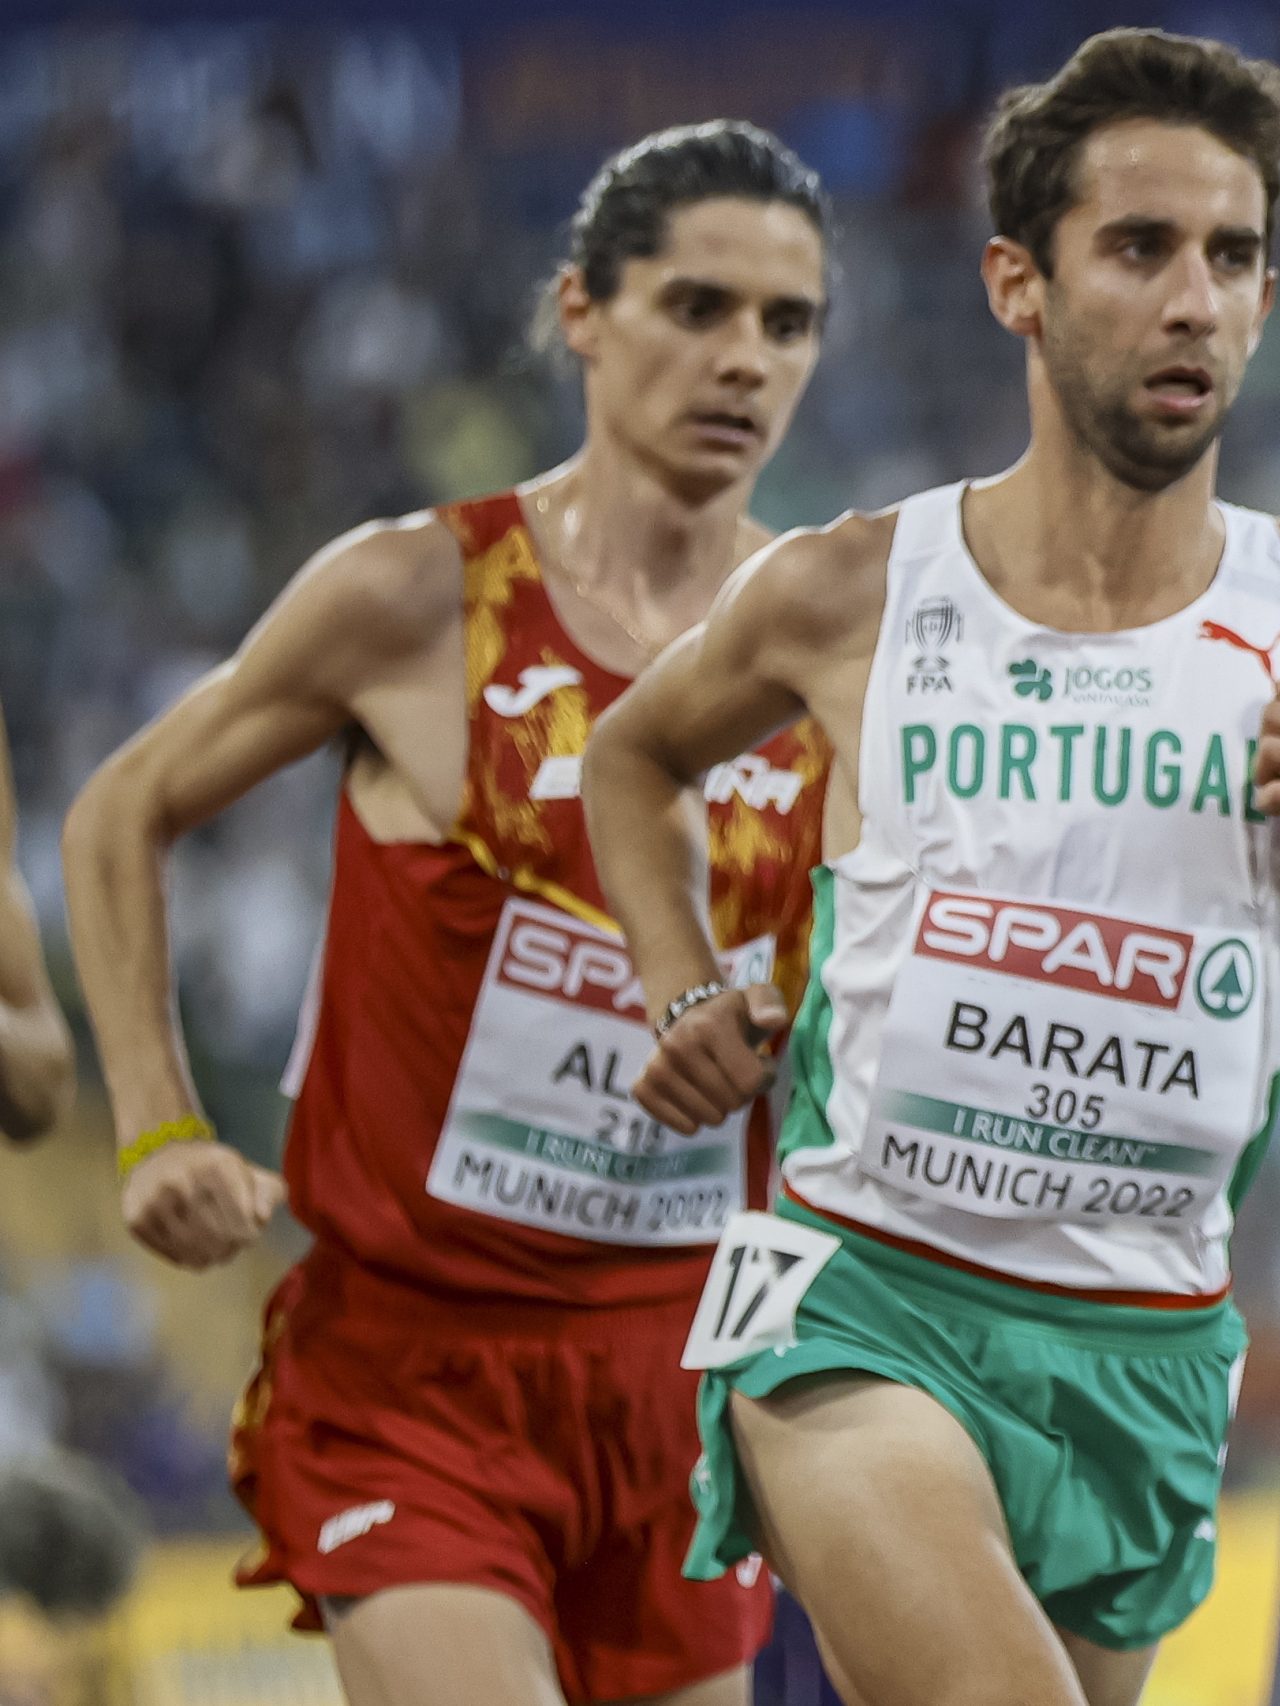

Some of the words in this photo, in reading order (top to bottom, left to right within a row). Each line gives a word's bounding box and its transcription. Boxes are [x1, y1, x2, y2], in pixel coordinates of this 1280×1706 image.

[906, 675, 954, 695] FPA
[1064, 665, 1153, 696] JOGOS
[902, 724, 1266, 823] PORTUGAL
[922, 898, 1186, 1000] SPAR
[945, 1001, 1199, 1098] BARATA
[953, 1108, 967, 1134] I
[971, 1111, 1044, 1152] RUN
[1048, 1132, 1144, 1166] CLEAN
[1024, 1084, 1104, 1130] 305
[451, 1156, 641, 1231] MUNICH
[881, 1136, 1073, 1211] MUNICH
[1081, 1179, 1194, 1217] 2022
[716, 1244, 806, 1342] 17
